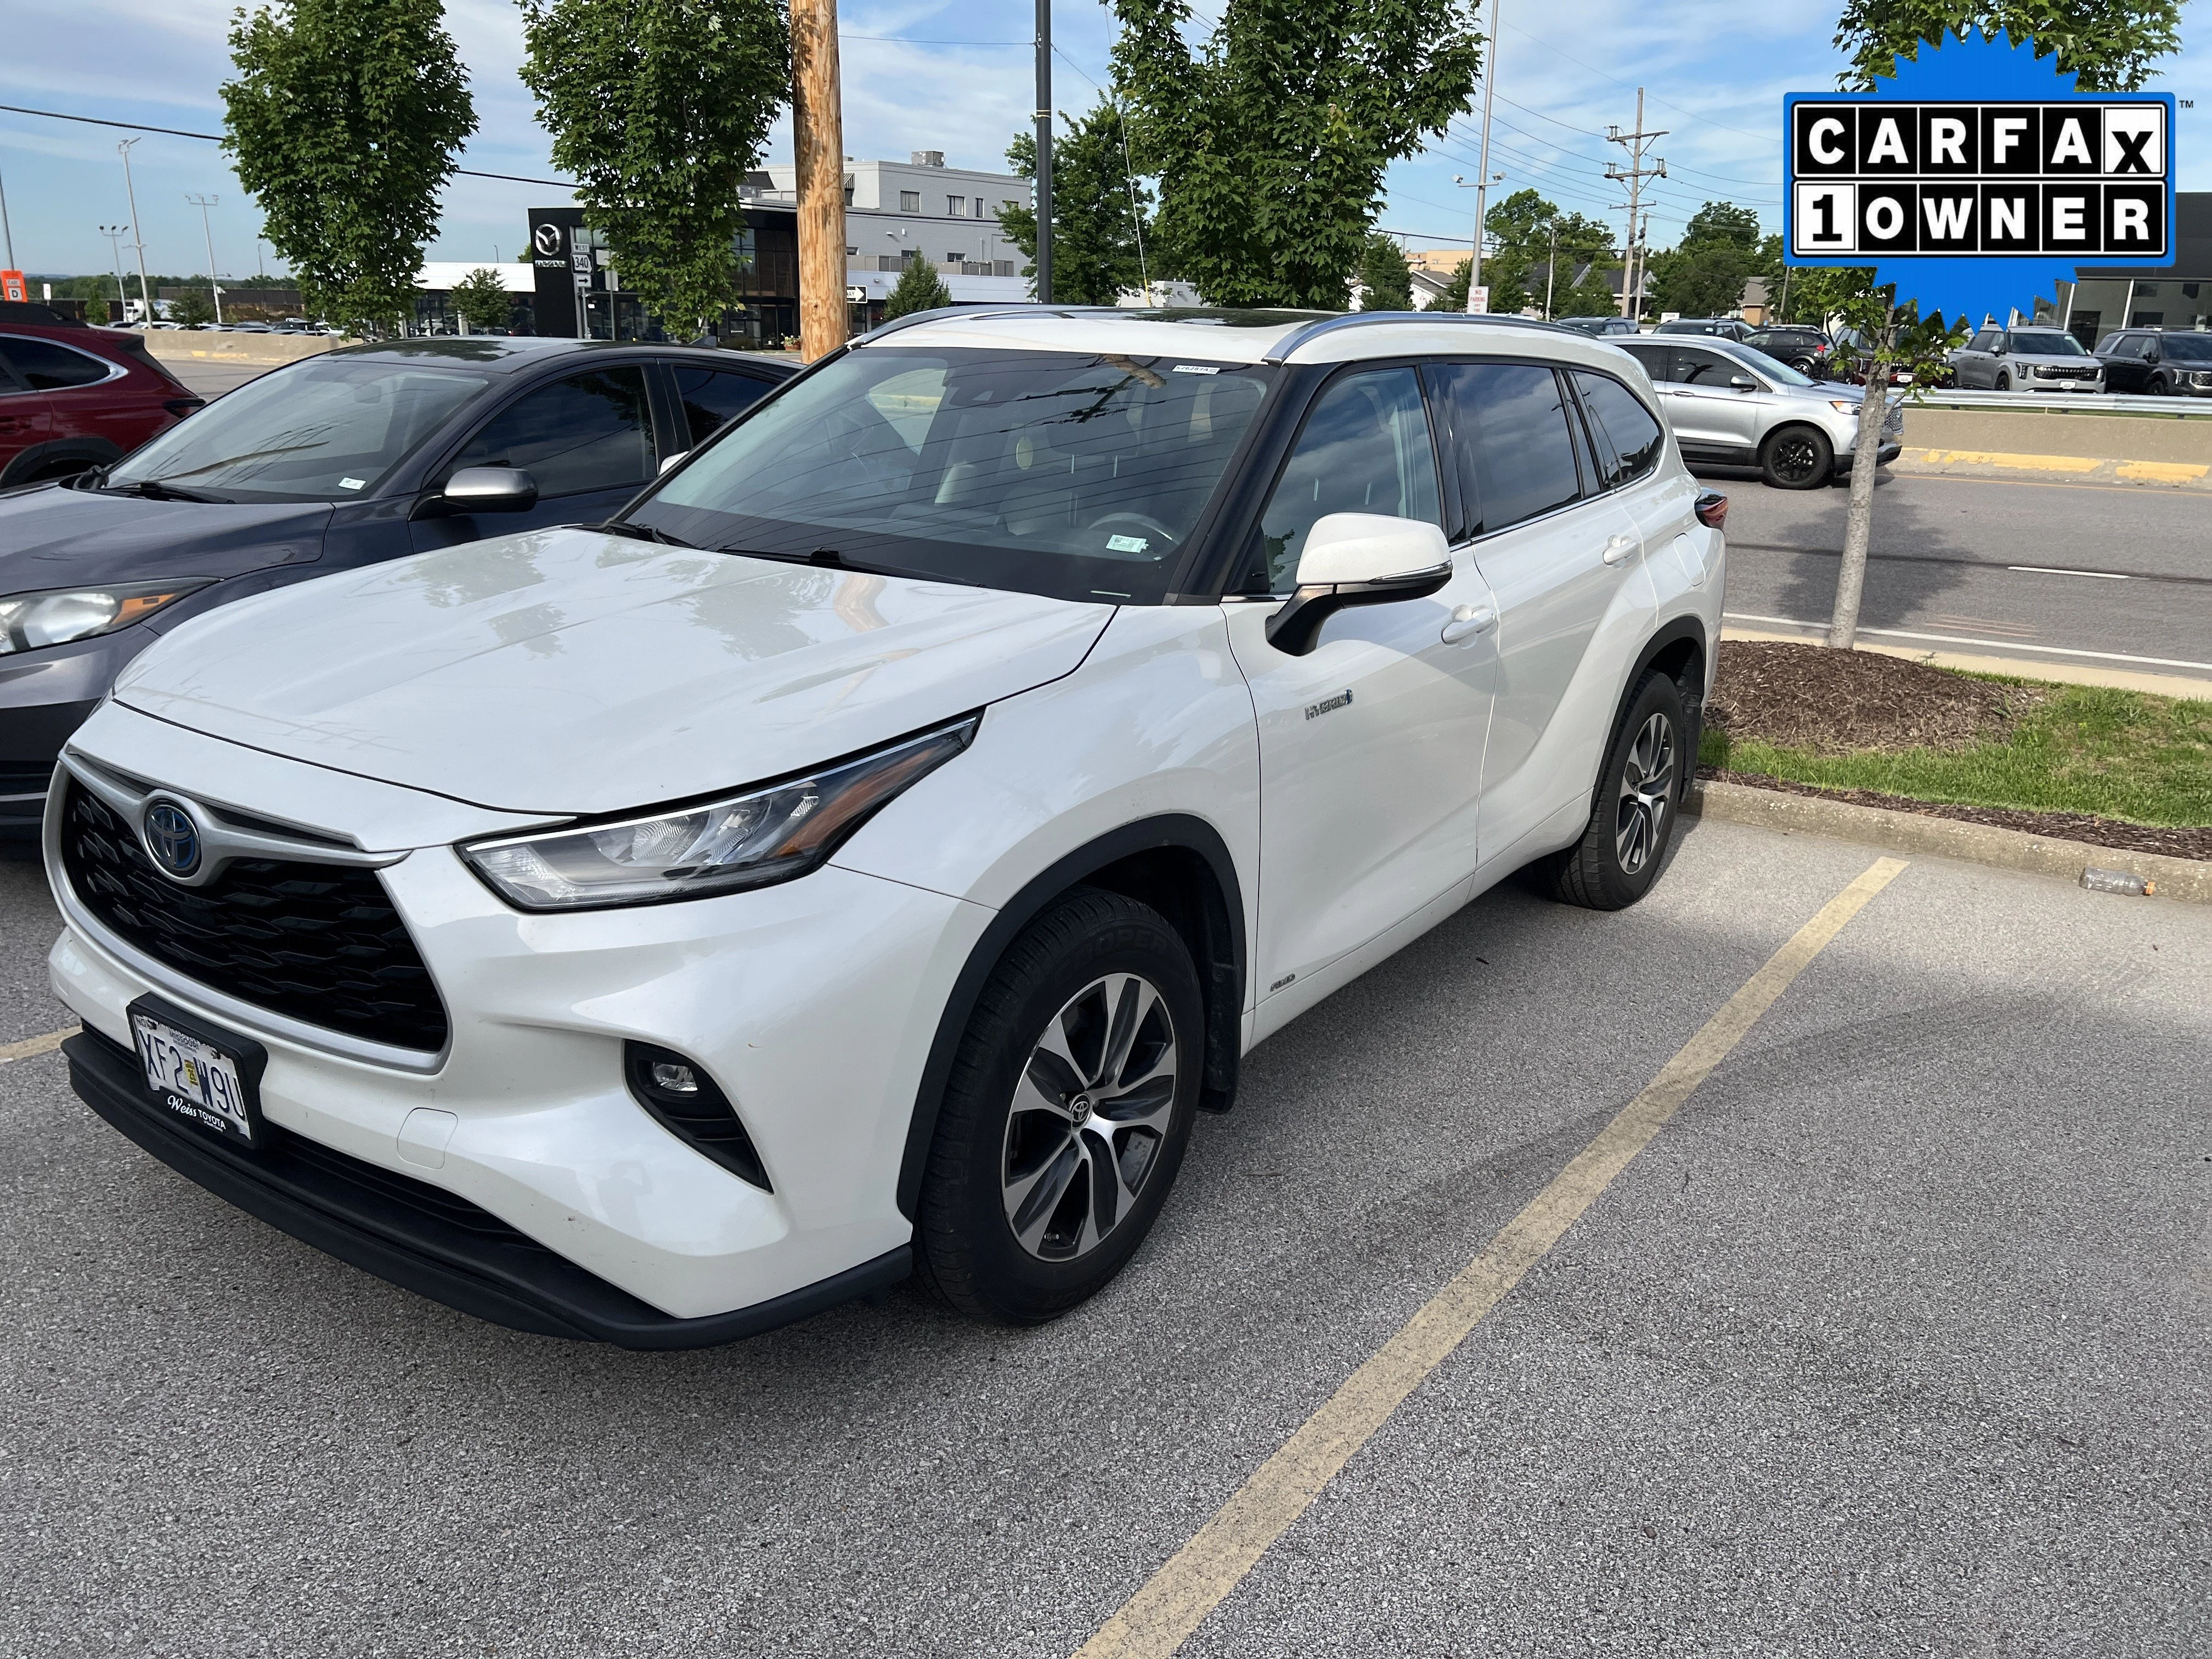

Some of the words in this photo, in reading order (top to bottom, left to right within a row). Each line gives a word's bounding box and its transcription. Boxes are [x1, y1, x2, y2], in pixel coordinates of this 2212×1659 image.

[575, 257, 588, 268] 340
[12, 290, 19, 298] D
[1305, 694, 1347, 720] HYBRID
[167, 1095, 197, 1117] Weiss
[198, 1109, 226, 1130] TOYOTA
